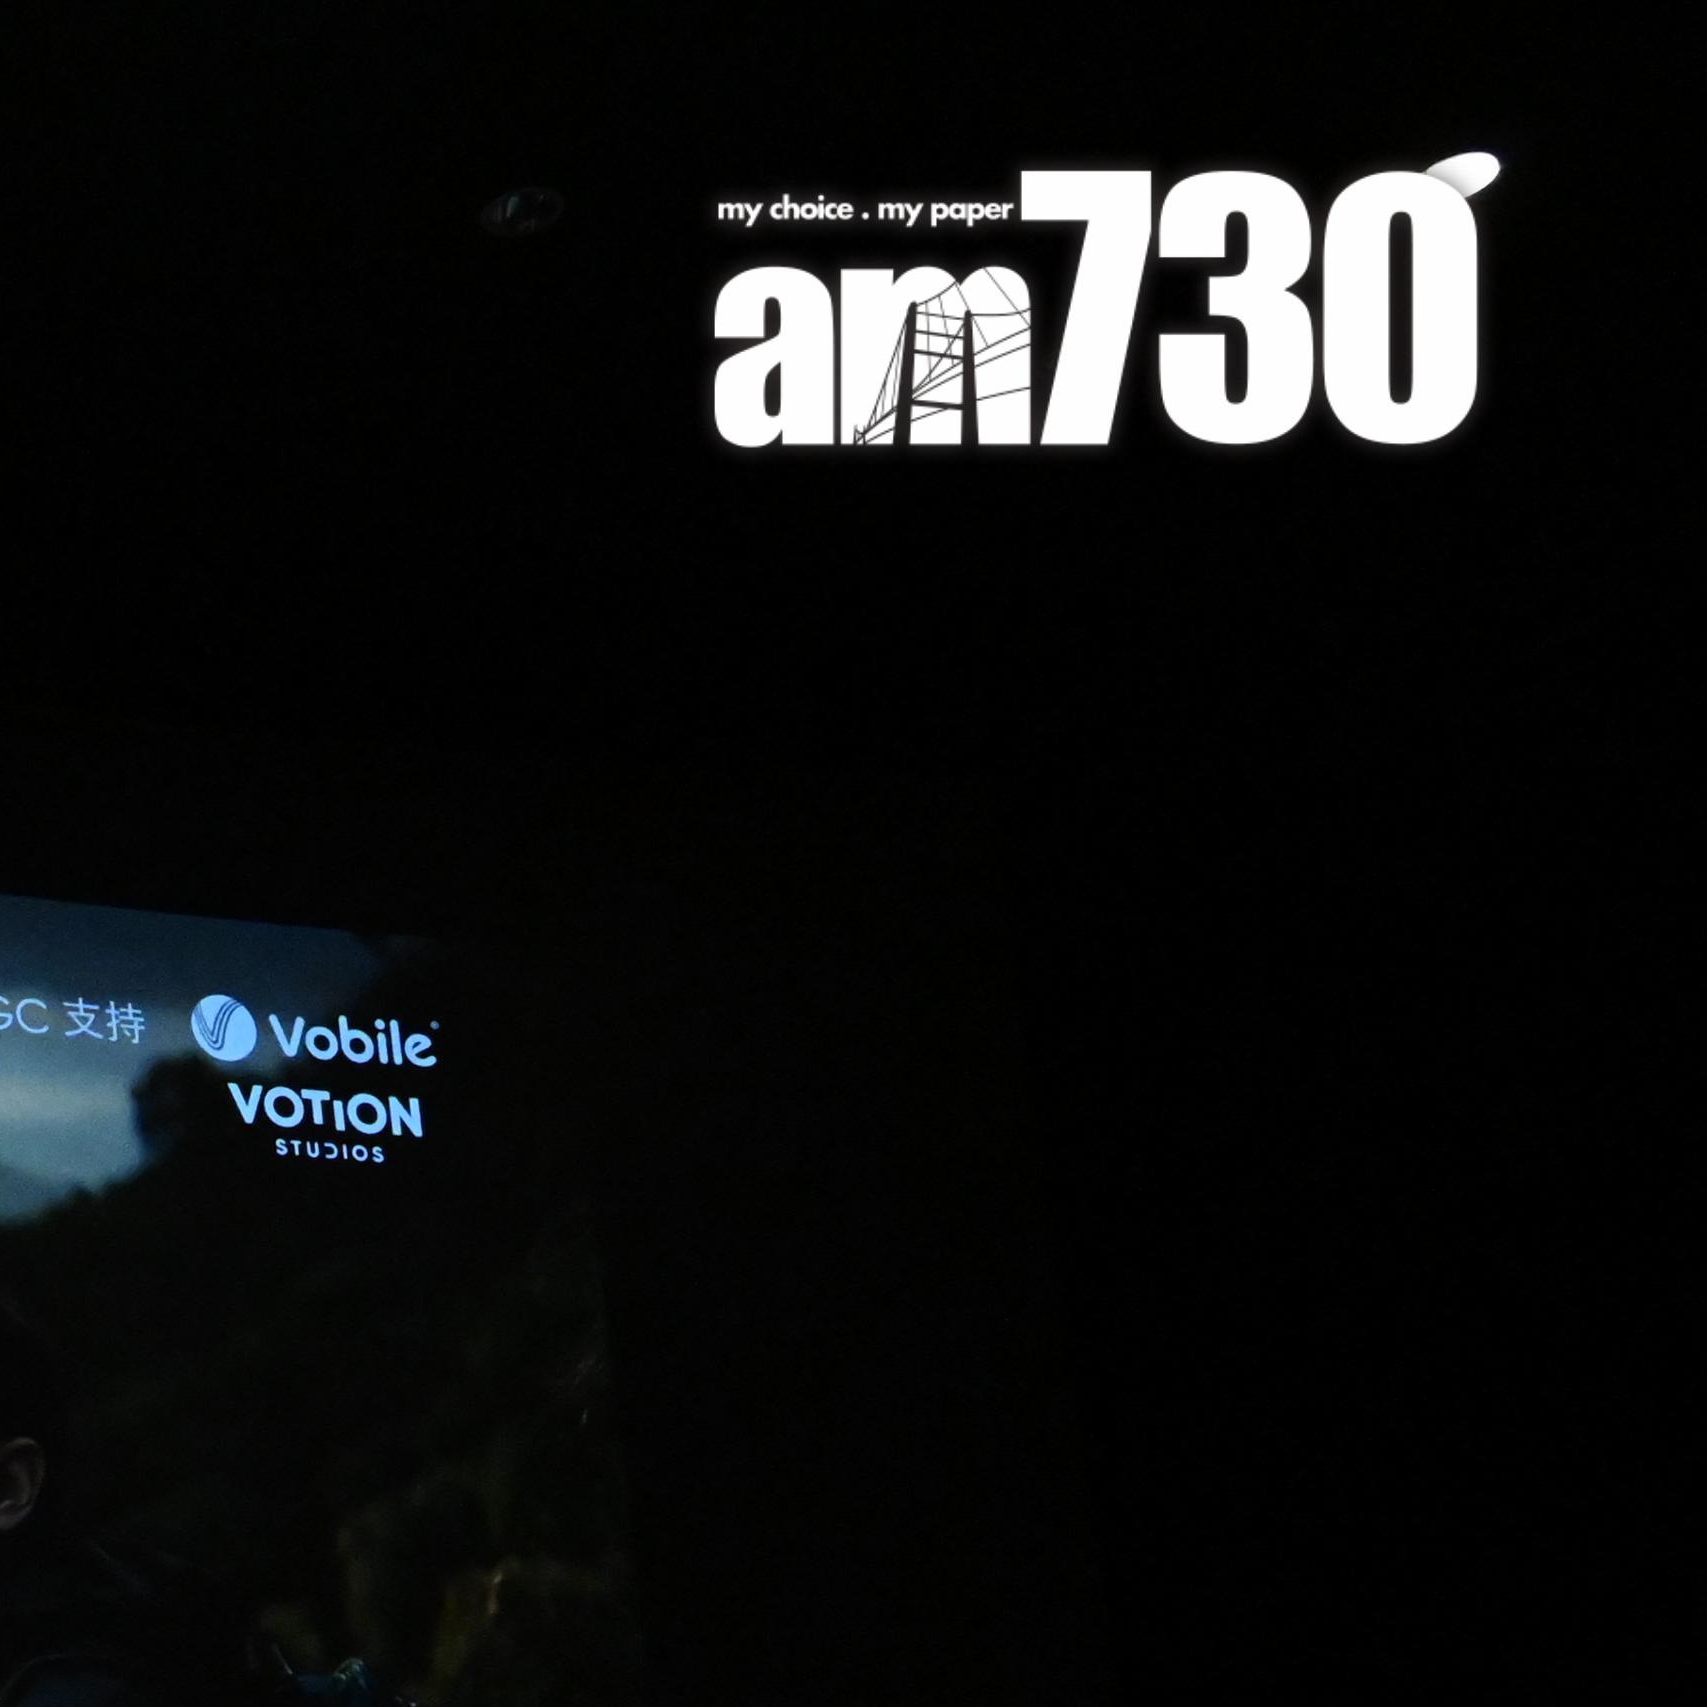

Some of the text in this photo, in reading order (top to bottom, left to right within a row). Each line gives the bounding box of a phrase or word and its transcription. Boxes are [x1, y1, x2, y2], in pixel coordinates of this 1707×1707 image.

[63, 997, 146, 1044] 支持
[268, 1013, 437, 1068] Vobile
[275, 1138, 386, 1163] STUDIOS
